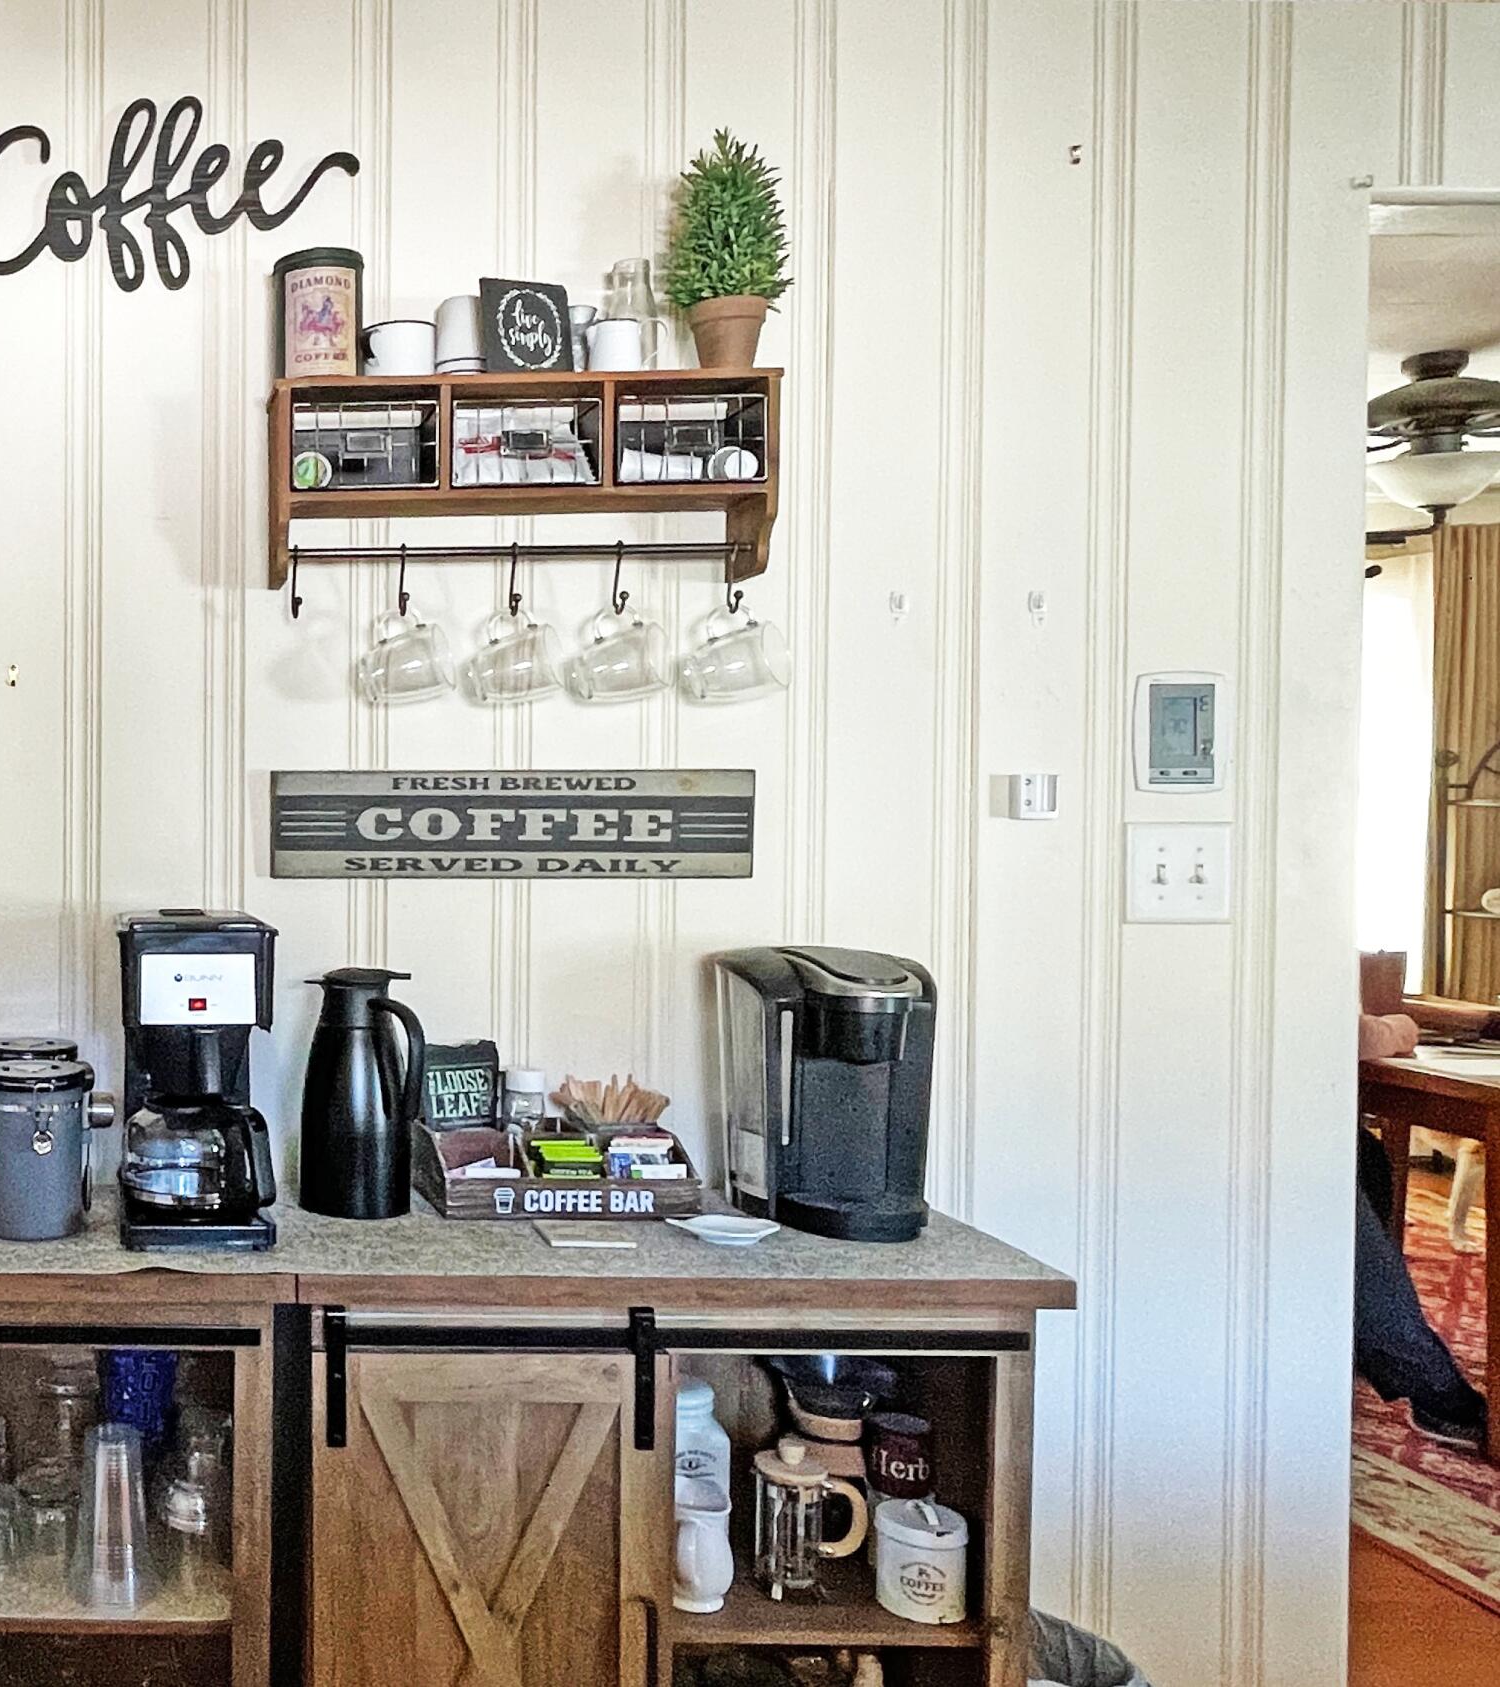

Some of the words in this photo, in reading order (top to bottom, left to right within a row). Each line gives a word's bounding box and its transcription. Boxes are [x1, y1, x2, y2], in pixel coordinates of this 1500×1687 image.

[290, 275, 352, 294] DIAMOND
[511, 299, 540, 330] live
[508, 320, 553, 358] simply
[391, 776, 491, 792] FRESH
[499, 776, 637, 792] BREWED
[354, 805, 674, 844] COFFEE
[344, 857, 524, 873] SERVED
[536, 857, 682, 874] DAILY
[435, 1068, 489, 1096] LOOSE
[431, 1092, 481, 1119] LEAF
[524, 1189, 603, 1213] COFFEE
[609, 1189, 655, 1213] BAR
